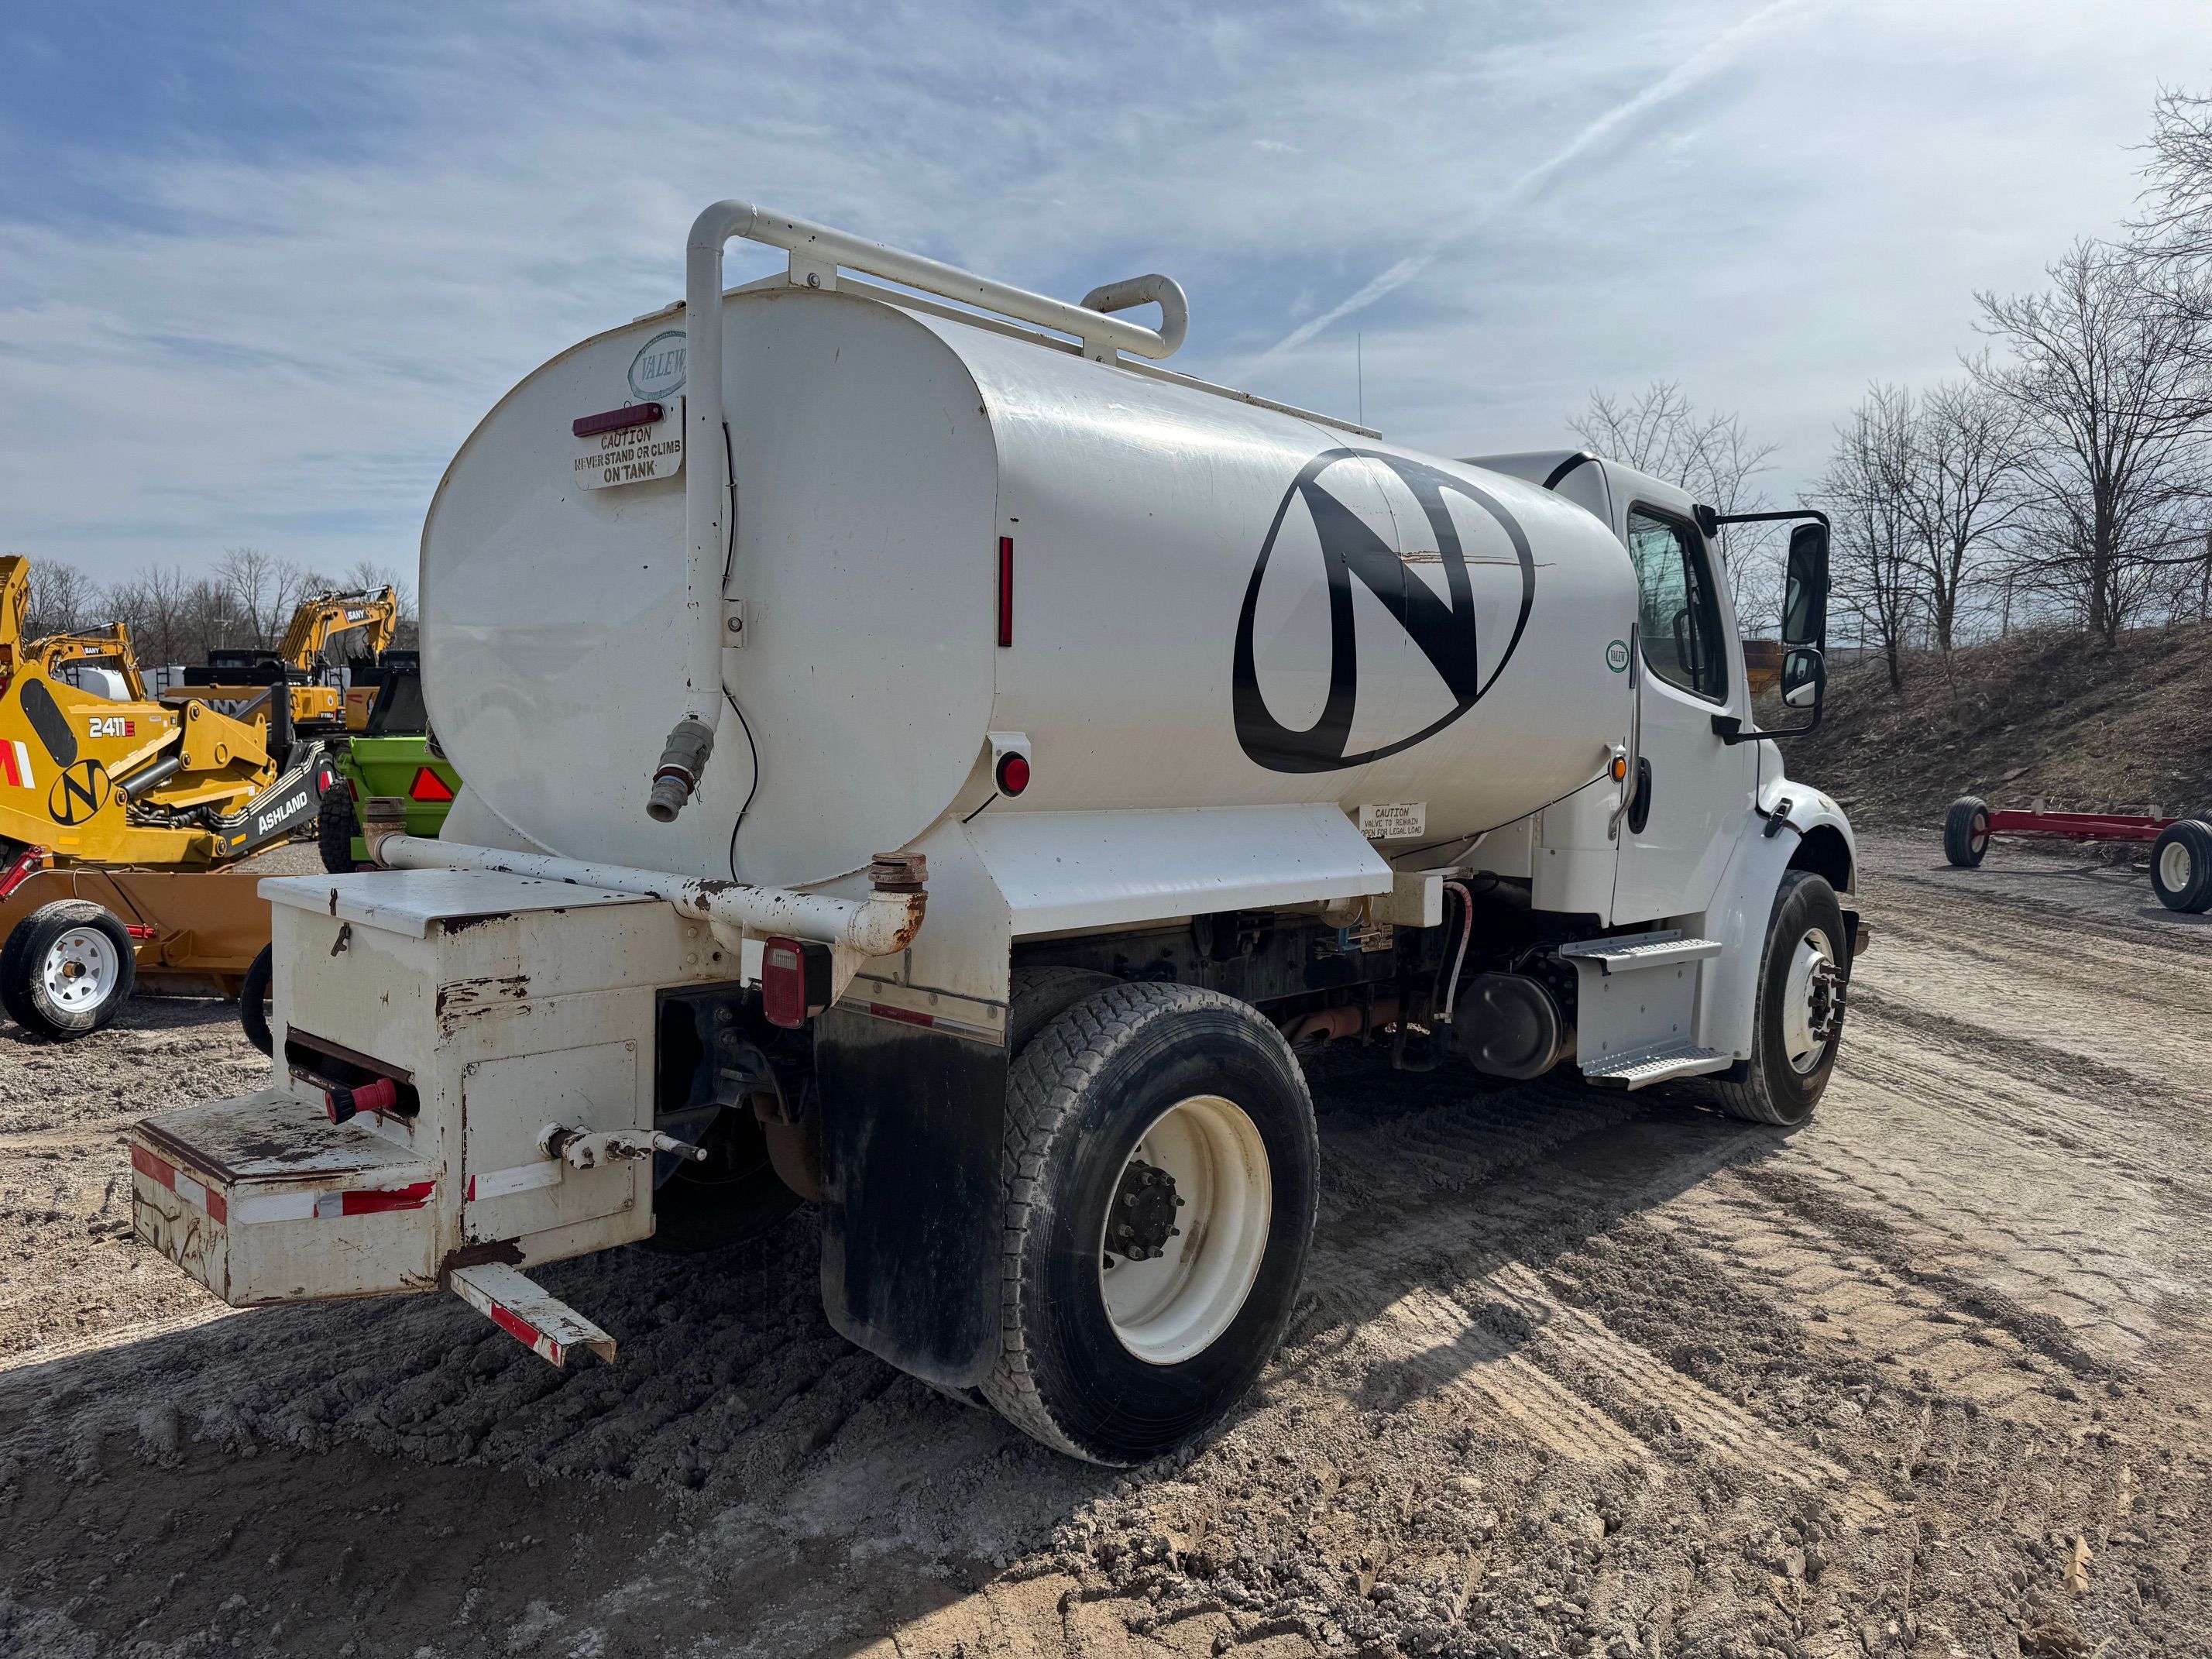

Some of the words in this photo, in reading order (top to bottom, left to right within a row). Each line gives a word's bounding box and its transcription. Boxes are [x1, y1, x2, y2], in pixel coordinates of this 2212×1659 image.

[641, 349, 686, 381] VALEW
[600, 426, 651, 450] CAUTION
[575, 454, 603, 471] NEVER
[604, 448, 634, 465] STAND
[637, 445, 650, 459] OR
[651, 439, 681, 457] CLIMB
[603, 466, 620, 483] ON
[623, 460, 655, 480] TANK
[347, 609, 365, 620] SANY
[89, 716, 135, 738] 2411E
[258, 791, 307, 836] ASHLAND
[1365, 819, 1383, 828] VALVE
[1395, 817, 1418, 826] REMAIN
[1376, 808, 1410, 818] CAUTION
[1361, 828, 1376, 837] OPEN
[1377, 828, 1388, 836] FOR
[1389, 827, 1407, 836] LEGAL
[1407, 826, 1422, 834] LOAD
